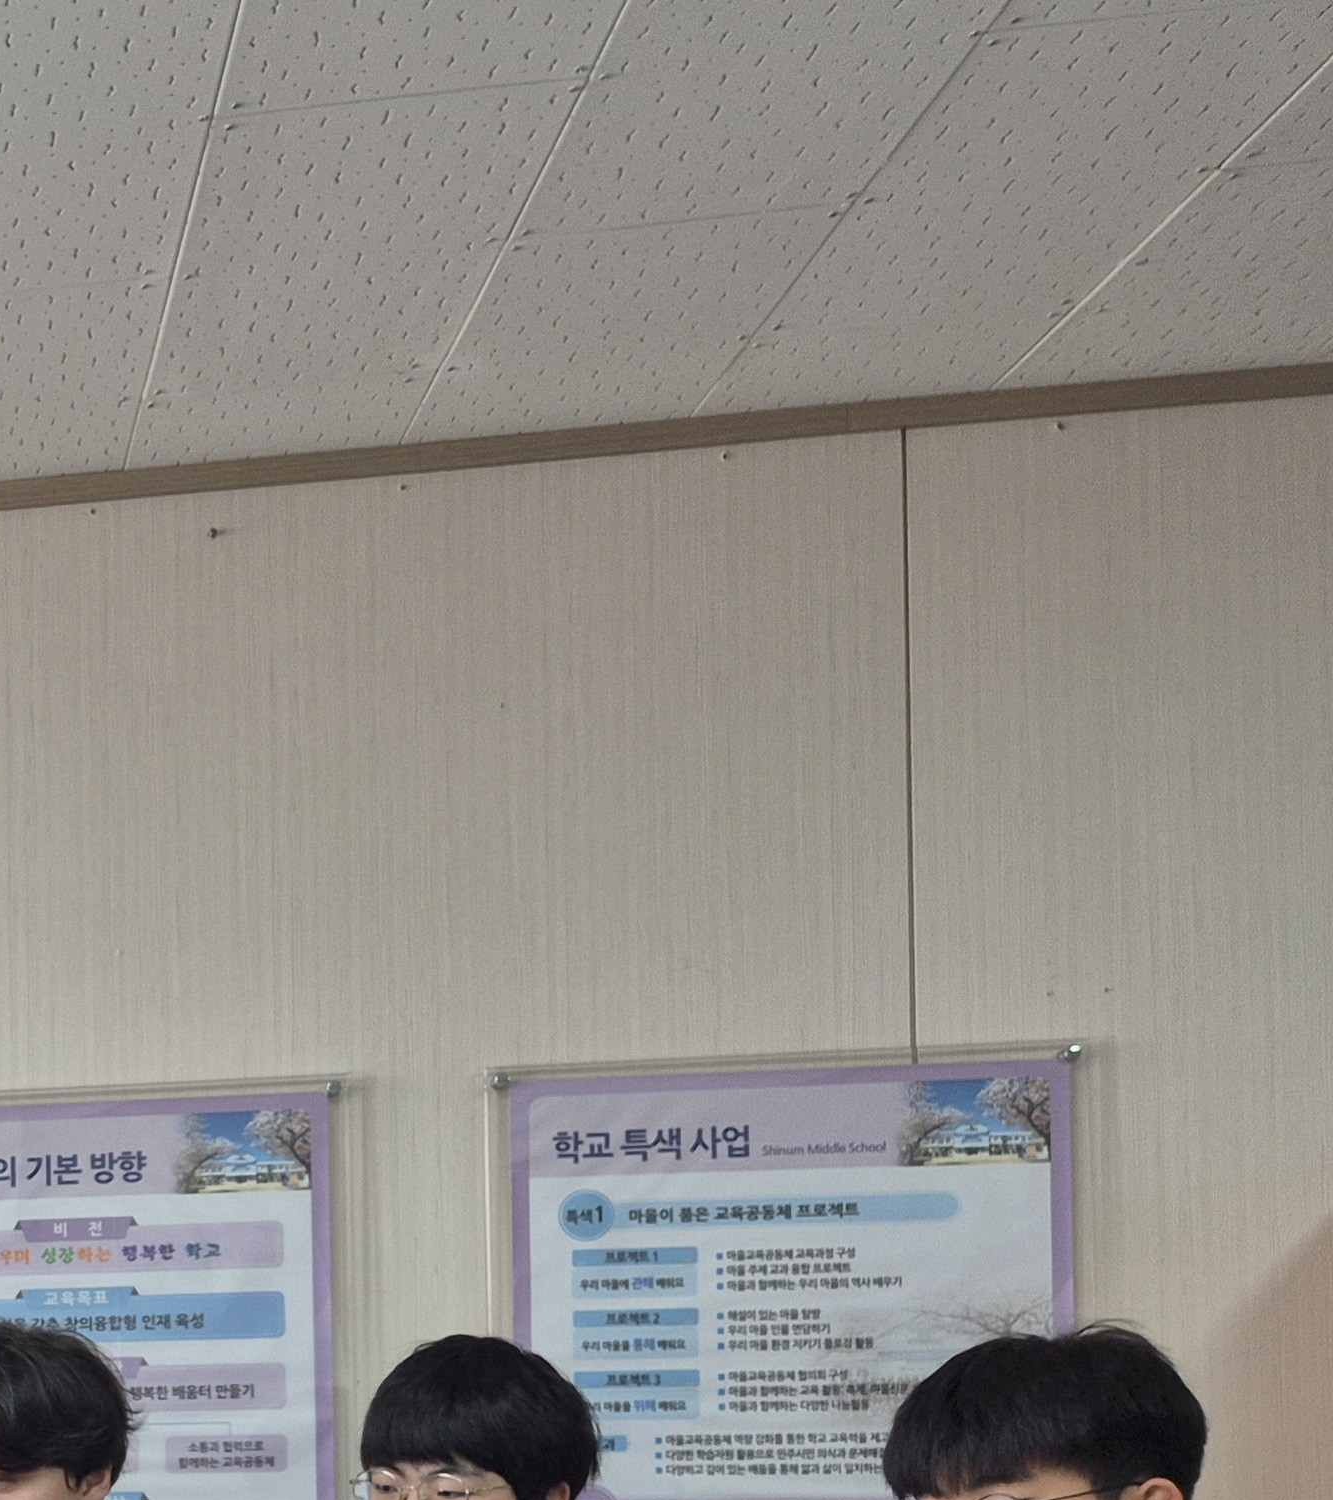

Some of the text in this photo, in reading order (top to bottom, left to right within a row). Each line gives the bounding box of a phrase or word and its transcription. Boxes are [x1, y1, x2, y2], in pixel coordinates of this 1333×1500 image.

[553, 1125, 750, 1163] 학교 특색 사업
[762, 1140, 886, 1157] Shinum Middle School
[26, 1154, 82, 1186] 기본
[90, 1151, 147, 1184] 방향
[629, 1208, 673, 1224] 마을이
[714, 1205, 791, 1221] 교육공동체
[797, 1203, 860, 1218] 프로젝트
[41, 1247, 112, 1264] 성장하는
[122, 1243, 175, 1262] 행복한
[186, 1242, 221, 1259] 학교
[44, 1290, 109, 1307] 교육목표
[65, 1313, 205, 1332] 창의융합형 인재 육성
[173, 1385, 211, 1400] 배움터
[216, 1384, 255, 1399] 만들기
